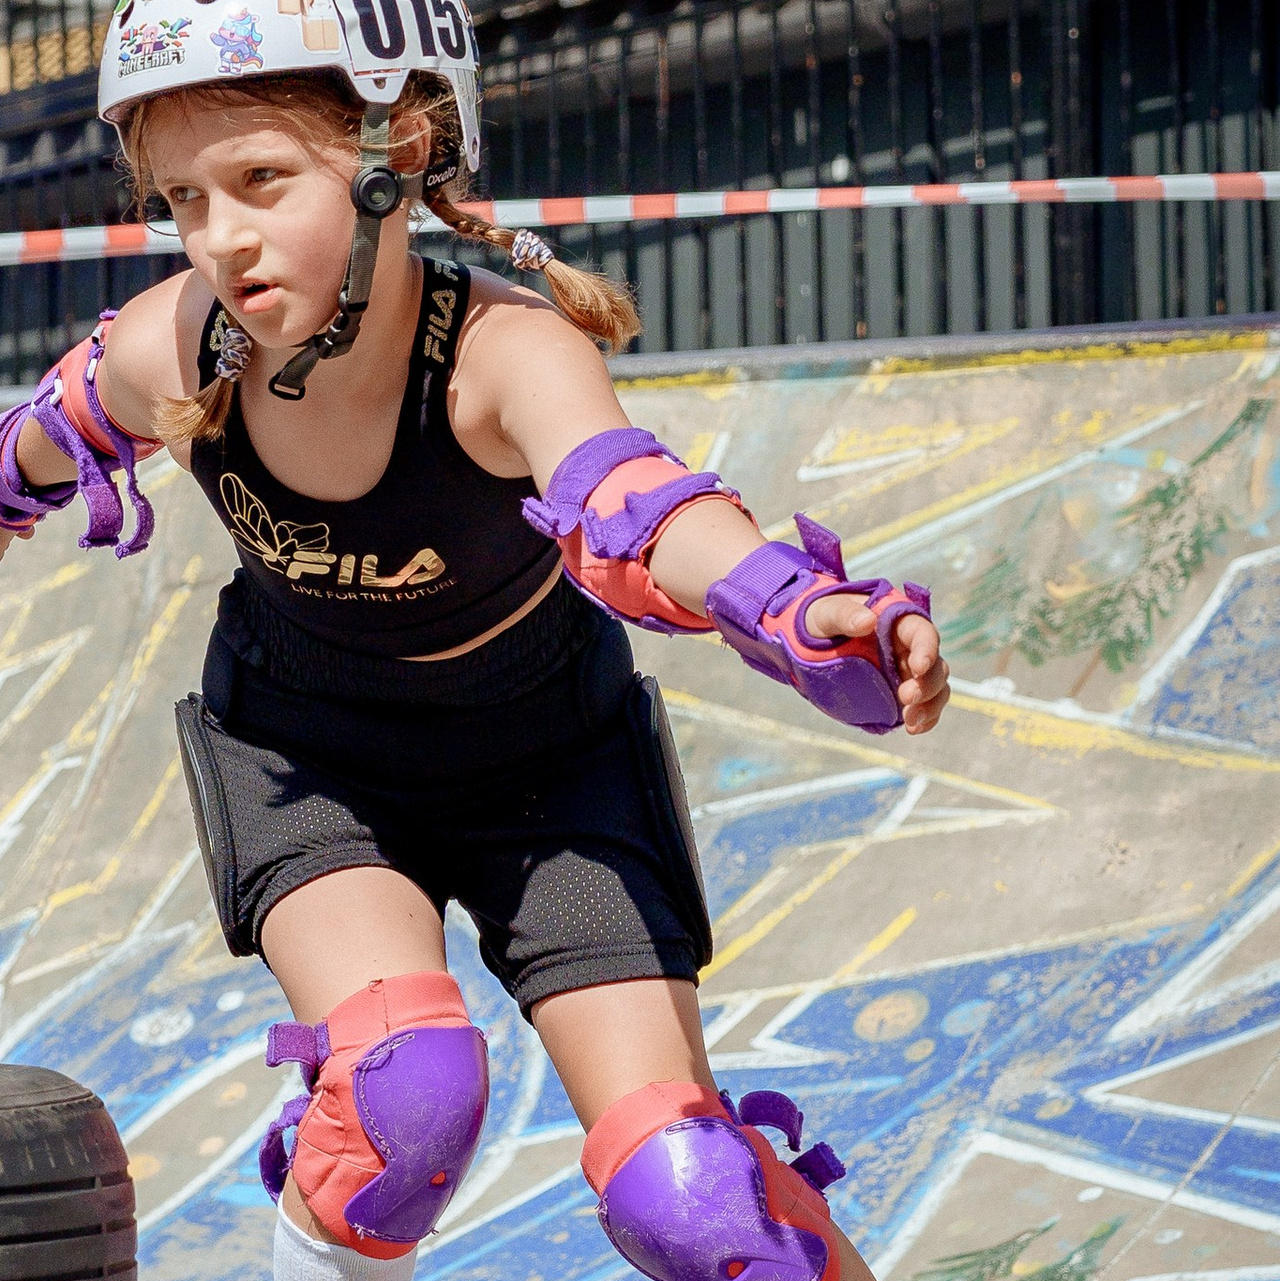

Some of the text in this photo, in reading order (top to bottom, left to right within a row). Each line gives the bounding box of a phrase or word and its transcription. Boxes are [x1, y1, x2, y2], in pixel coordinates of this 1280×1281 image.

[118, 49, 186, 78] MINECRAFT
[423, 288, 457, 364] FILA
[286, 547, 446, 588] FILA
[291, 578, 459, 602] LIVE FOR THE FUTURE
